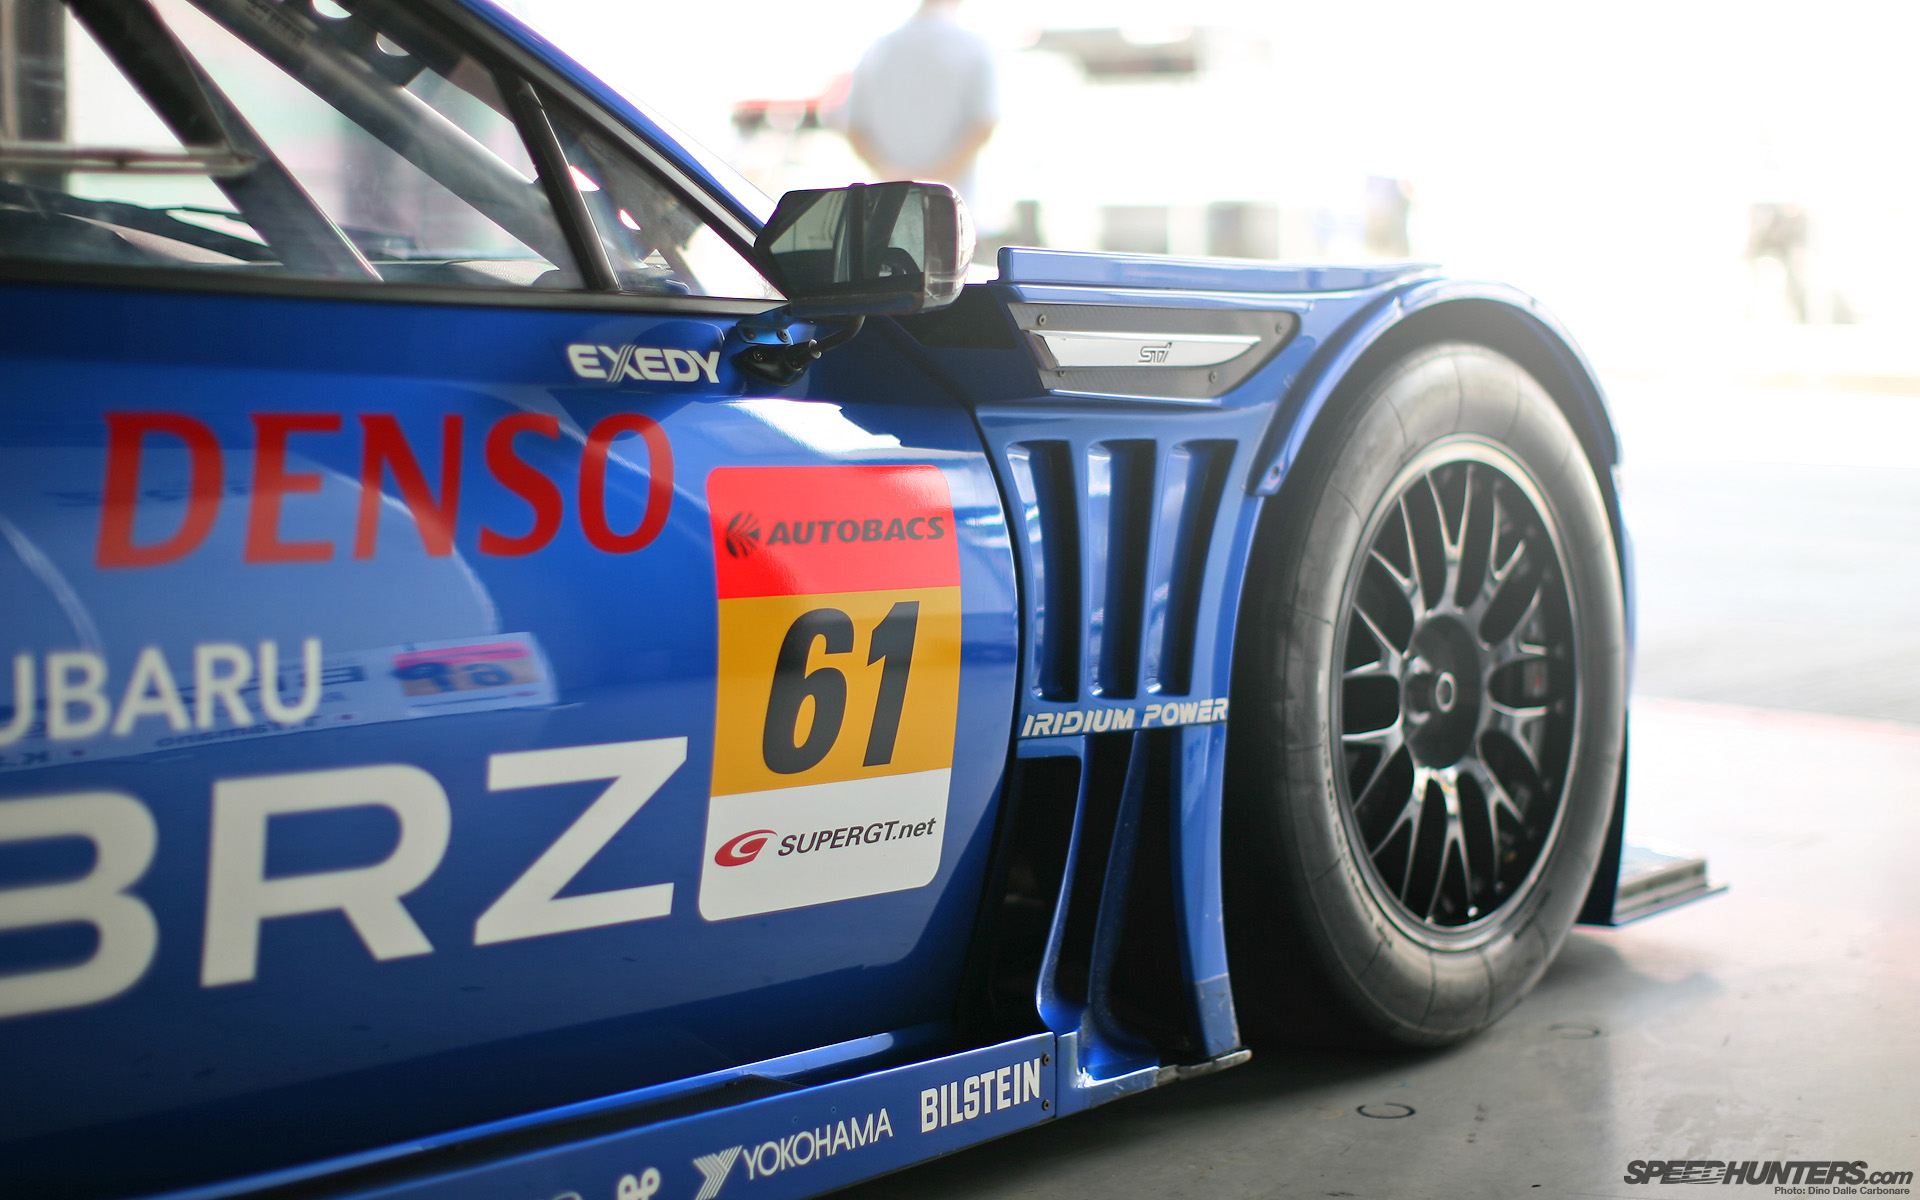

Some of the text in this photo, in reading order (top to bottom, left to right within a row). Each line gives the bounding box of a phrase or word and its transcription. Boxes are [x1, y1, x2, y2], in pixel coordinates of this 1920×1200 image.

[567, 344, 721, 384] EXEDY
[95, 411, 675, 570] DENSO
[765, 516, 945, 546] AUTOBACS
[762, 601, 920, 775] 61
[1021, 697, 1229, 737] IRIDIUM POWER
[777, 816, 937, 858] SUPERGT.net
[0, 736, 688, 1019] BRZ
[920, 1058, 1041, 1134] BILSTEIN
[742, 1107, 893, 1181] YOKOHAMA
